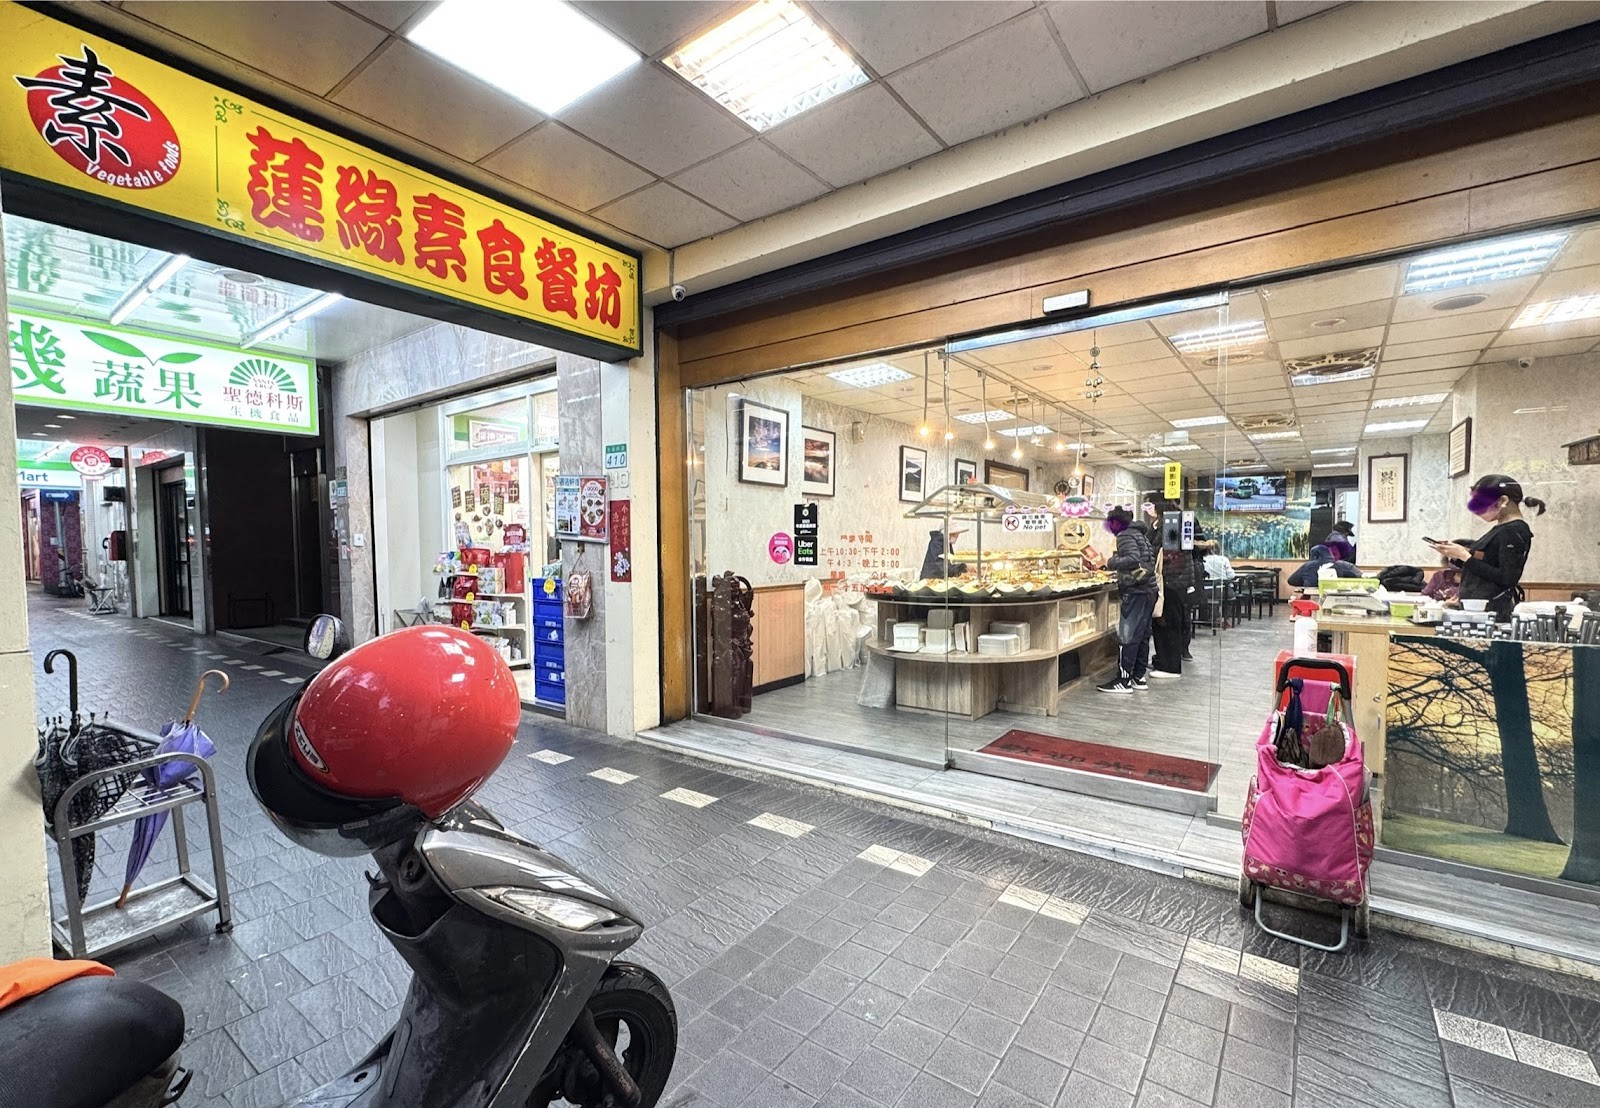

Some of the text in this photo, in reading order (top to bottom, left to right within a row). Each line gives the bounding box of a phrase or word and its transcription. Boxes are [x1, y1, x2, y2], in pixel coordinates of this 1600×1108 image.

[13, 43, 151, 167] 素
[86, 140, 179, 187] Vegetable foods
[246, 126, 622, 329] 蓮緣素食餐坊
[92, 359, 203, 409] 蔬果
[223, 386, 303, 411] 聖德科斯
[230, 405, 299, 423] 生機食品
[606, 453, 626, 466] 410
[1184, 520, 1192, 541] 自動門
[797, 540, 814, 548] Uber
[871, 571, 888, 580] 公休
